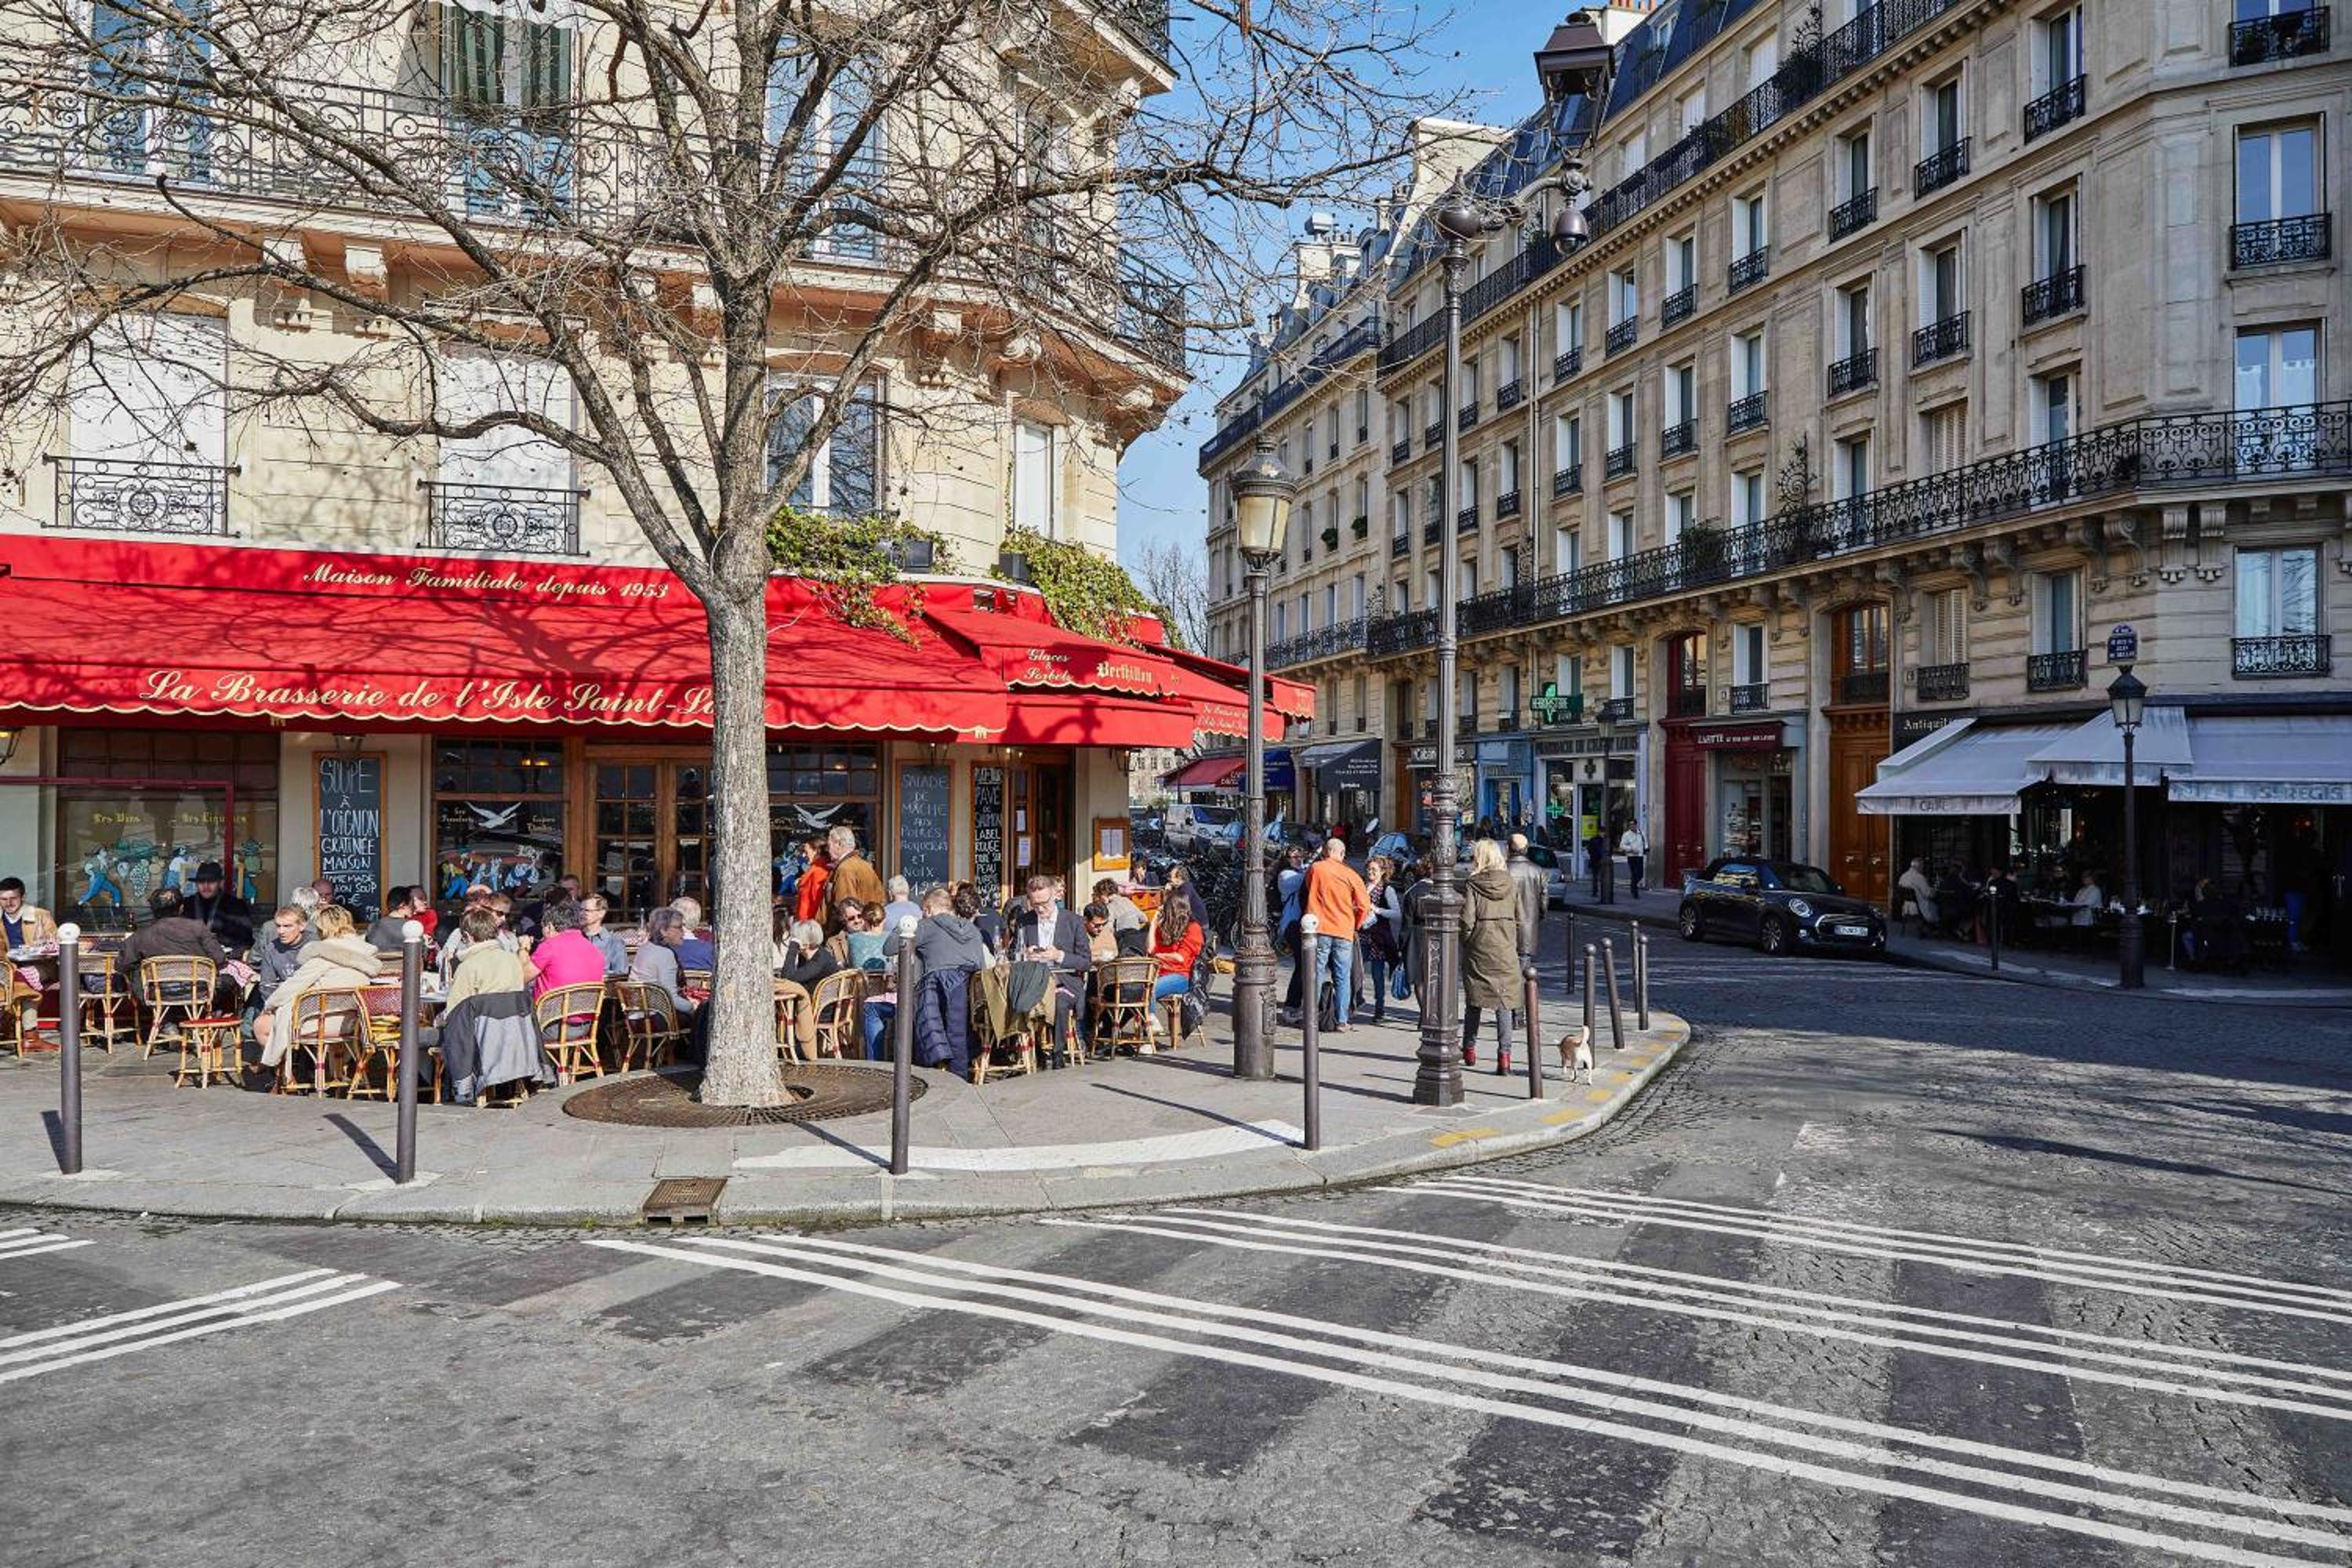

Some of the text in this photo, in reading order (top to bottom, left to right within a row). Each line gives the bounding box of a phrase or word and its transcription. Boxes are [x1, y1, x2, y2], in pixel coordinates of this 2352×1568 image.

[303, 563, 669, 601] Maison Familiale depuis 1953
[1026, 648, 1072, 662] Glaces
[1023, 666, 1074, 682] Sorbets
[1096, 661, 1153, 684] Berthillon
[139, 670, 199, 700] La
[211, 673, 390, 706] Brasserie
[398, 680, 445, 707] de
[455, 680, 557, 710] l'Isle
[320, 758, 376, 793] SOUPE
[902, 774, 949, 789] SALADE
[975, 829, 1001, 840] LABEL
[321, 836, 376, 855] GRATINÉE
[902, 866, 935, 878] NOIX
